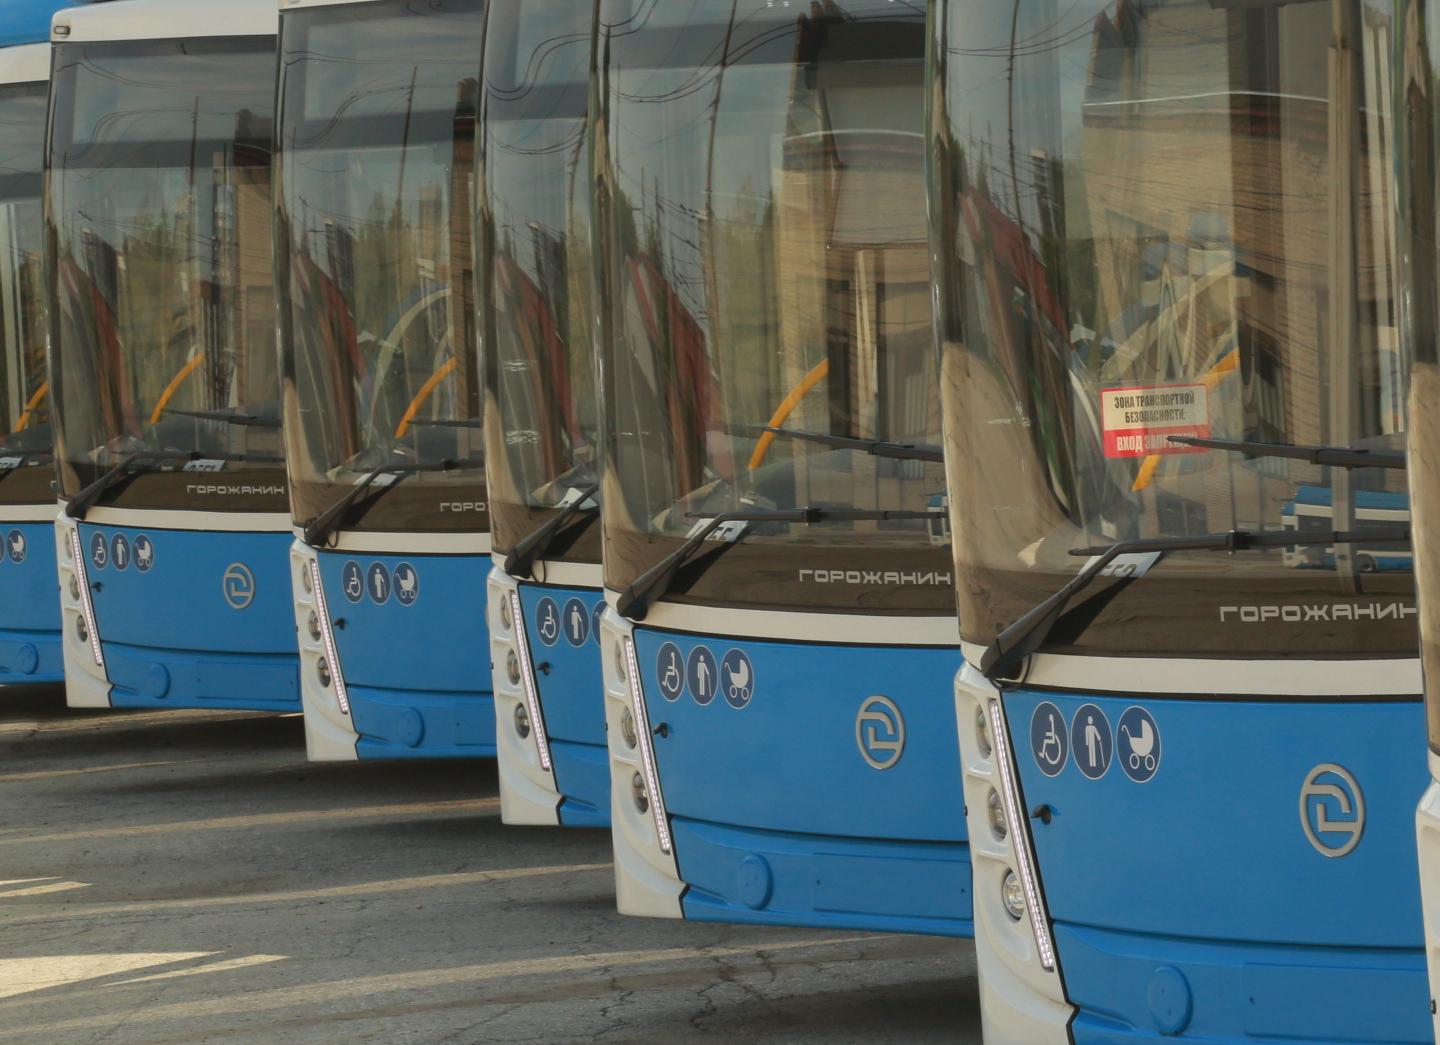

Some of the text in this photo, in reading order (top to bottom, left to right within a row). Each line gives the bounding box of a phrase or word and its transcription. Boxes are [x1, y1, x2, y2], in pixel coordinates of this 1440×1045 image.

[1114, 391, 1195, 409] ЗОНА ТРАНСПОРТНОЙ
[1116, 435, 1144, 452] ВХОД
[186, 485, 285, 495] ГОРОЖАНИН
[440, 502, 489, 512] ГОРО
[799, 569, 951, 585] ГОРОЖАНИН
[1219, 603, 1417, 622] ГОРОЖАНИН
